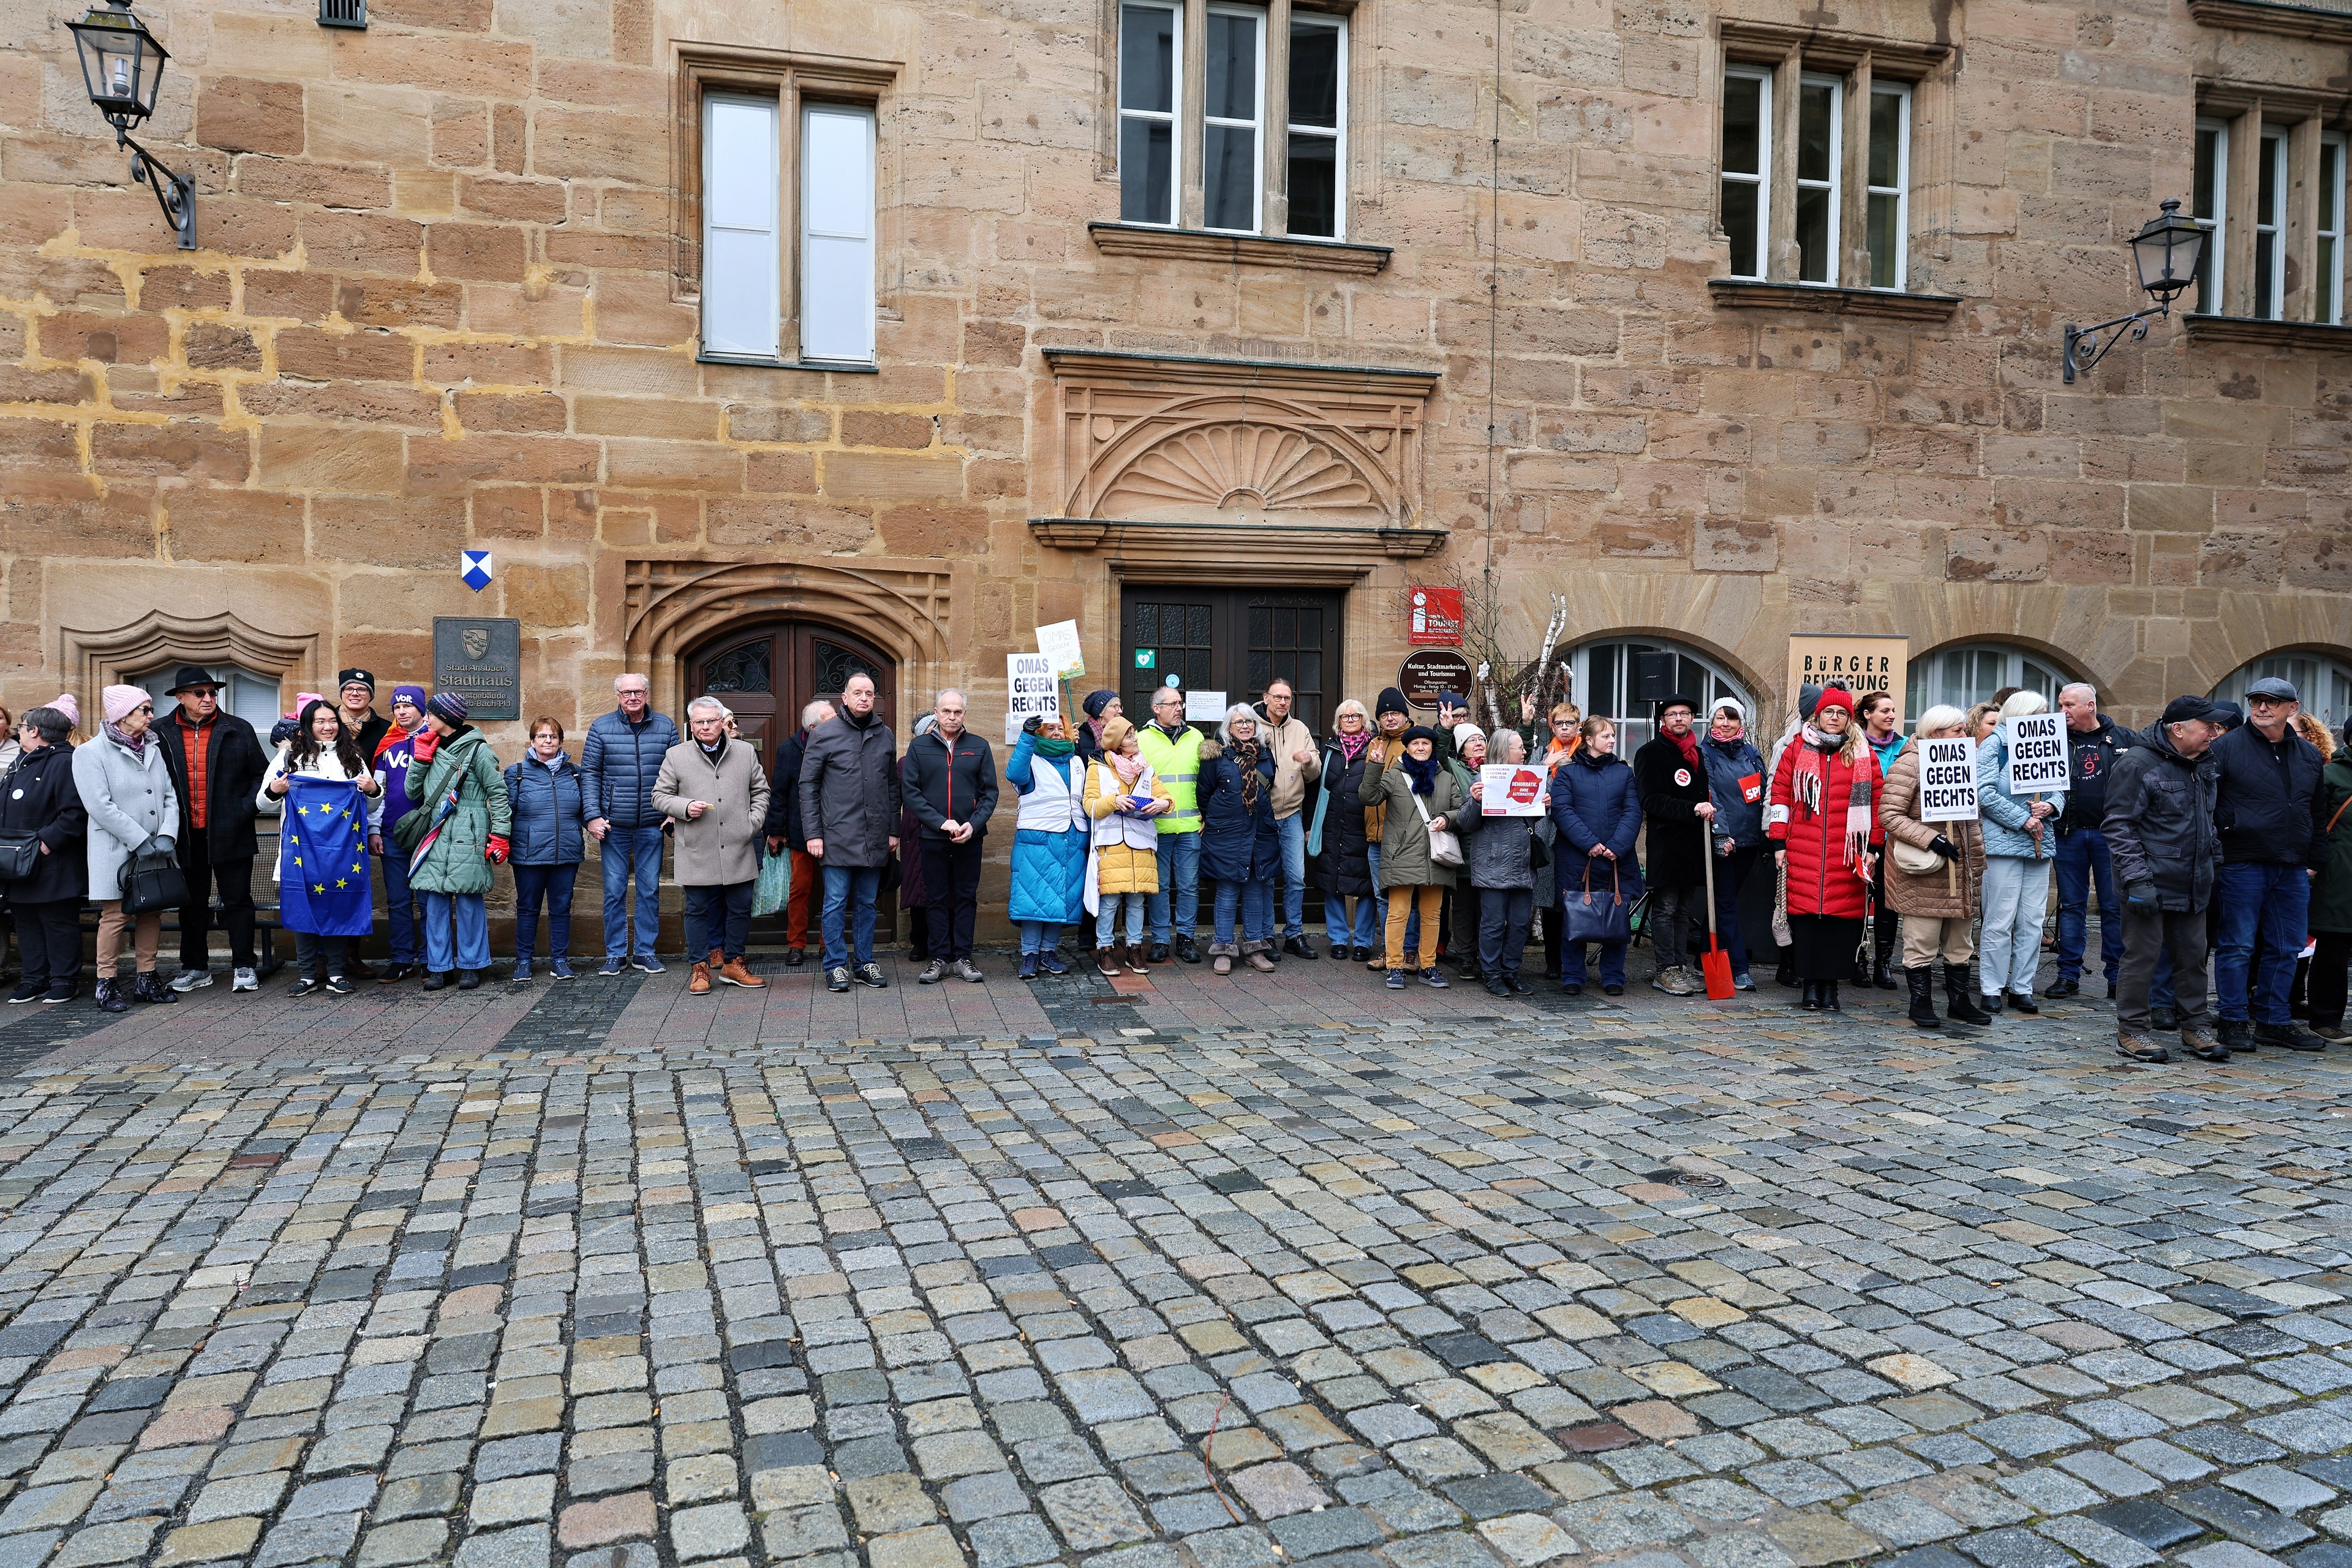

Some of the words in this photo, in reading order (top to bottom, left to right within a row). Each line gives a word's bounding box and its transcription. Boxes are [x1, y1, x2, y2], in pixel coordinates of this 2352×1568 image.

[1043, 629, 1071, 644] OMAS
[1047, 643, 1069, 652] GEGEN
[1058, 650, 1075, 663] CHTS
[446, 663, 468, 672] Stadt
[1017, 658, 1049, 674] OMAS
[439, 674, 513, 687] Stadthaus
[1014, 677, 1052, 693] GEGEN
[1804, 674, 1888, 690] BEWGUNG
[395, 694, 413, 703] Volt
[1012, 696, 1057, 712] RECHTS
[2018, 718, 2056, 739] OMAS
[1929, 744, 1966, 763] OMAS
[2015, 739, 2060, 760] GEGEN
[388, 750, 415, 768] Vo
[1926, 766, 1970, 785] GEGEN
[2013, 760, 2066, 781] RECHTS
[1924, 788, 1975, 808] RECHTS
